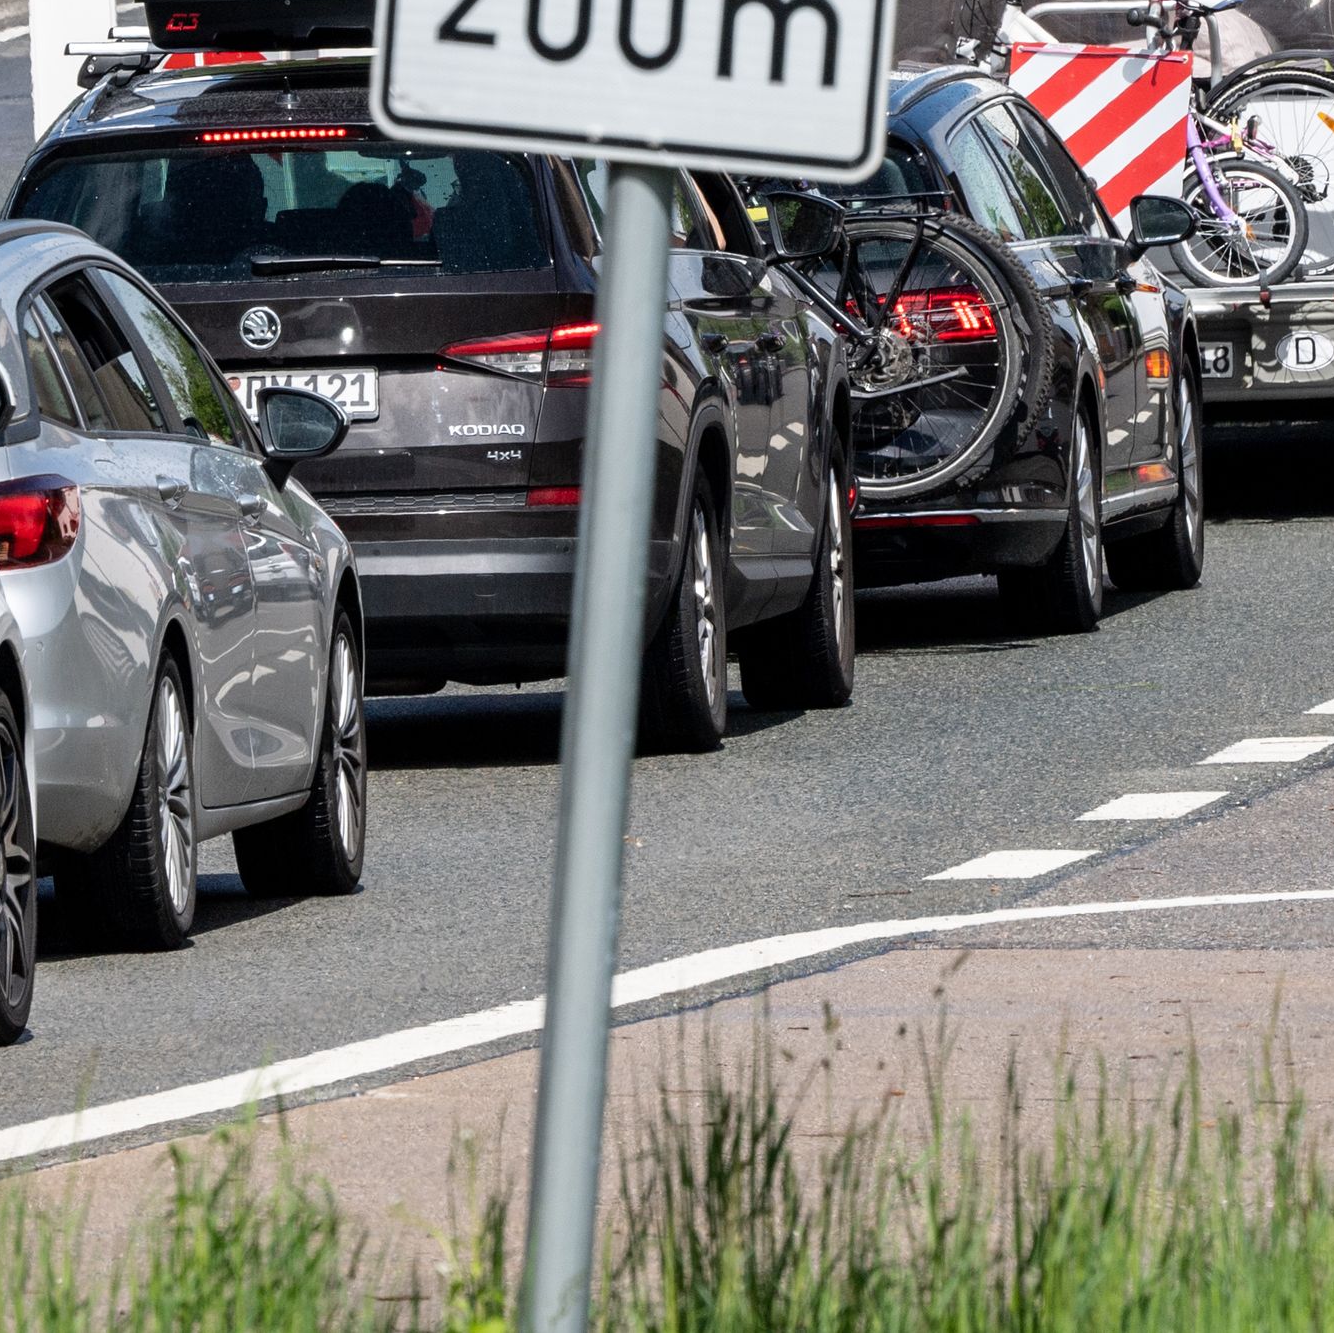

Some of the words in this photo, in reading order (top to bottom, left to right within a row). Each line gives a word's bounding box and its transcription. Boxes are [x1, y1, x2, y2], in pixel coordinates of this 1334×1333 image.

[1295, 336, 1316, 365] D
[448, 424, 525, 437] KODIAQ
[486, 451, 522, 461] 4x4
